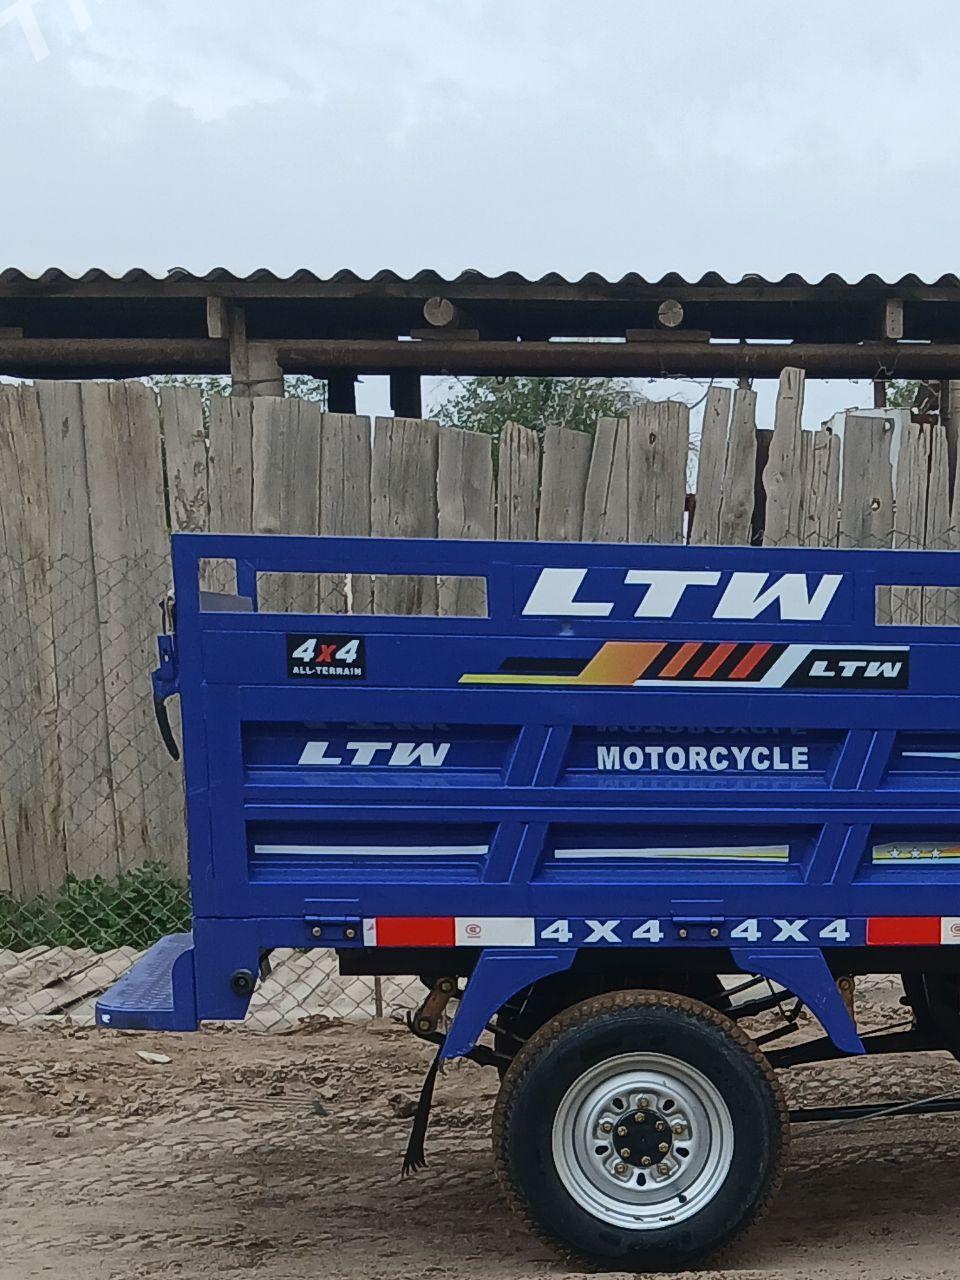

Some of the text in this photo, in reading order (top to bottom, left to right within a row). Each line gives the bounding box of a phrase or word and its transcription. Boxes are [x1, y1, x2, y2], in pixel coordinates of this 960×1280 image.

[521, 567, 844, 621] LTW
[292, 666, 362, 676] ALL-TERRAIN
[808, 660, 902, 678] LTW
[297, 741, 451, 767] LTW
[597, 746, 809, 771] MOTORCYCLE
